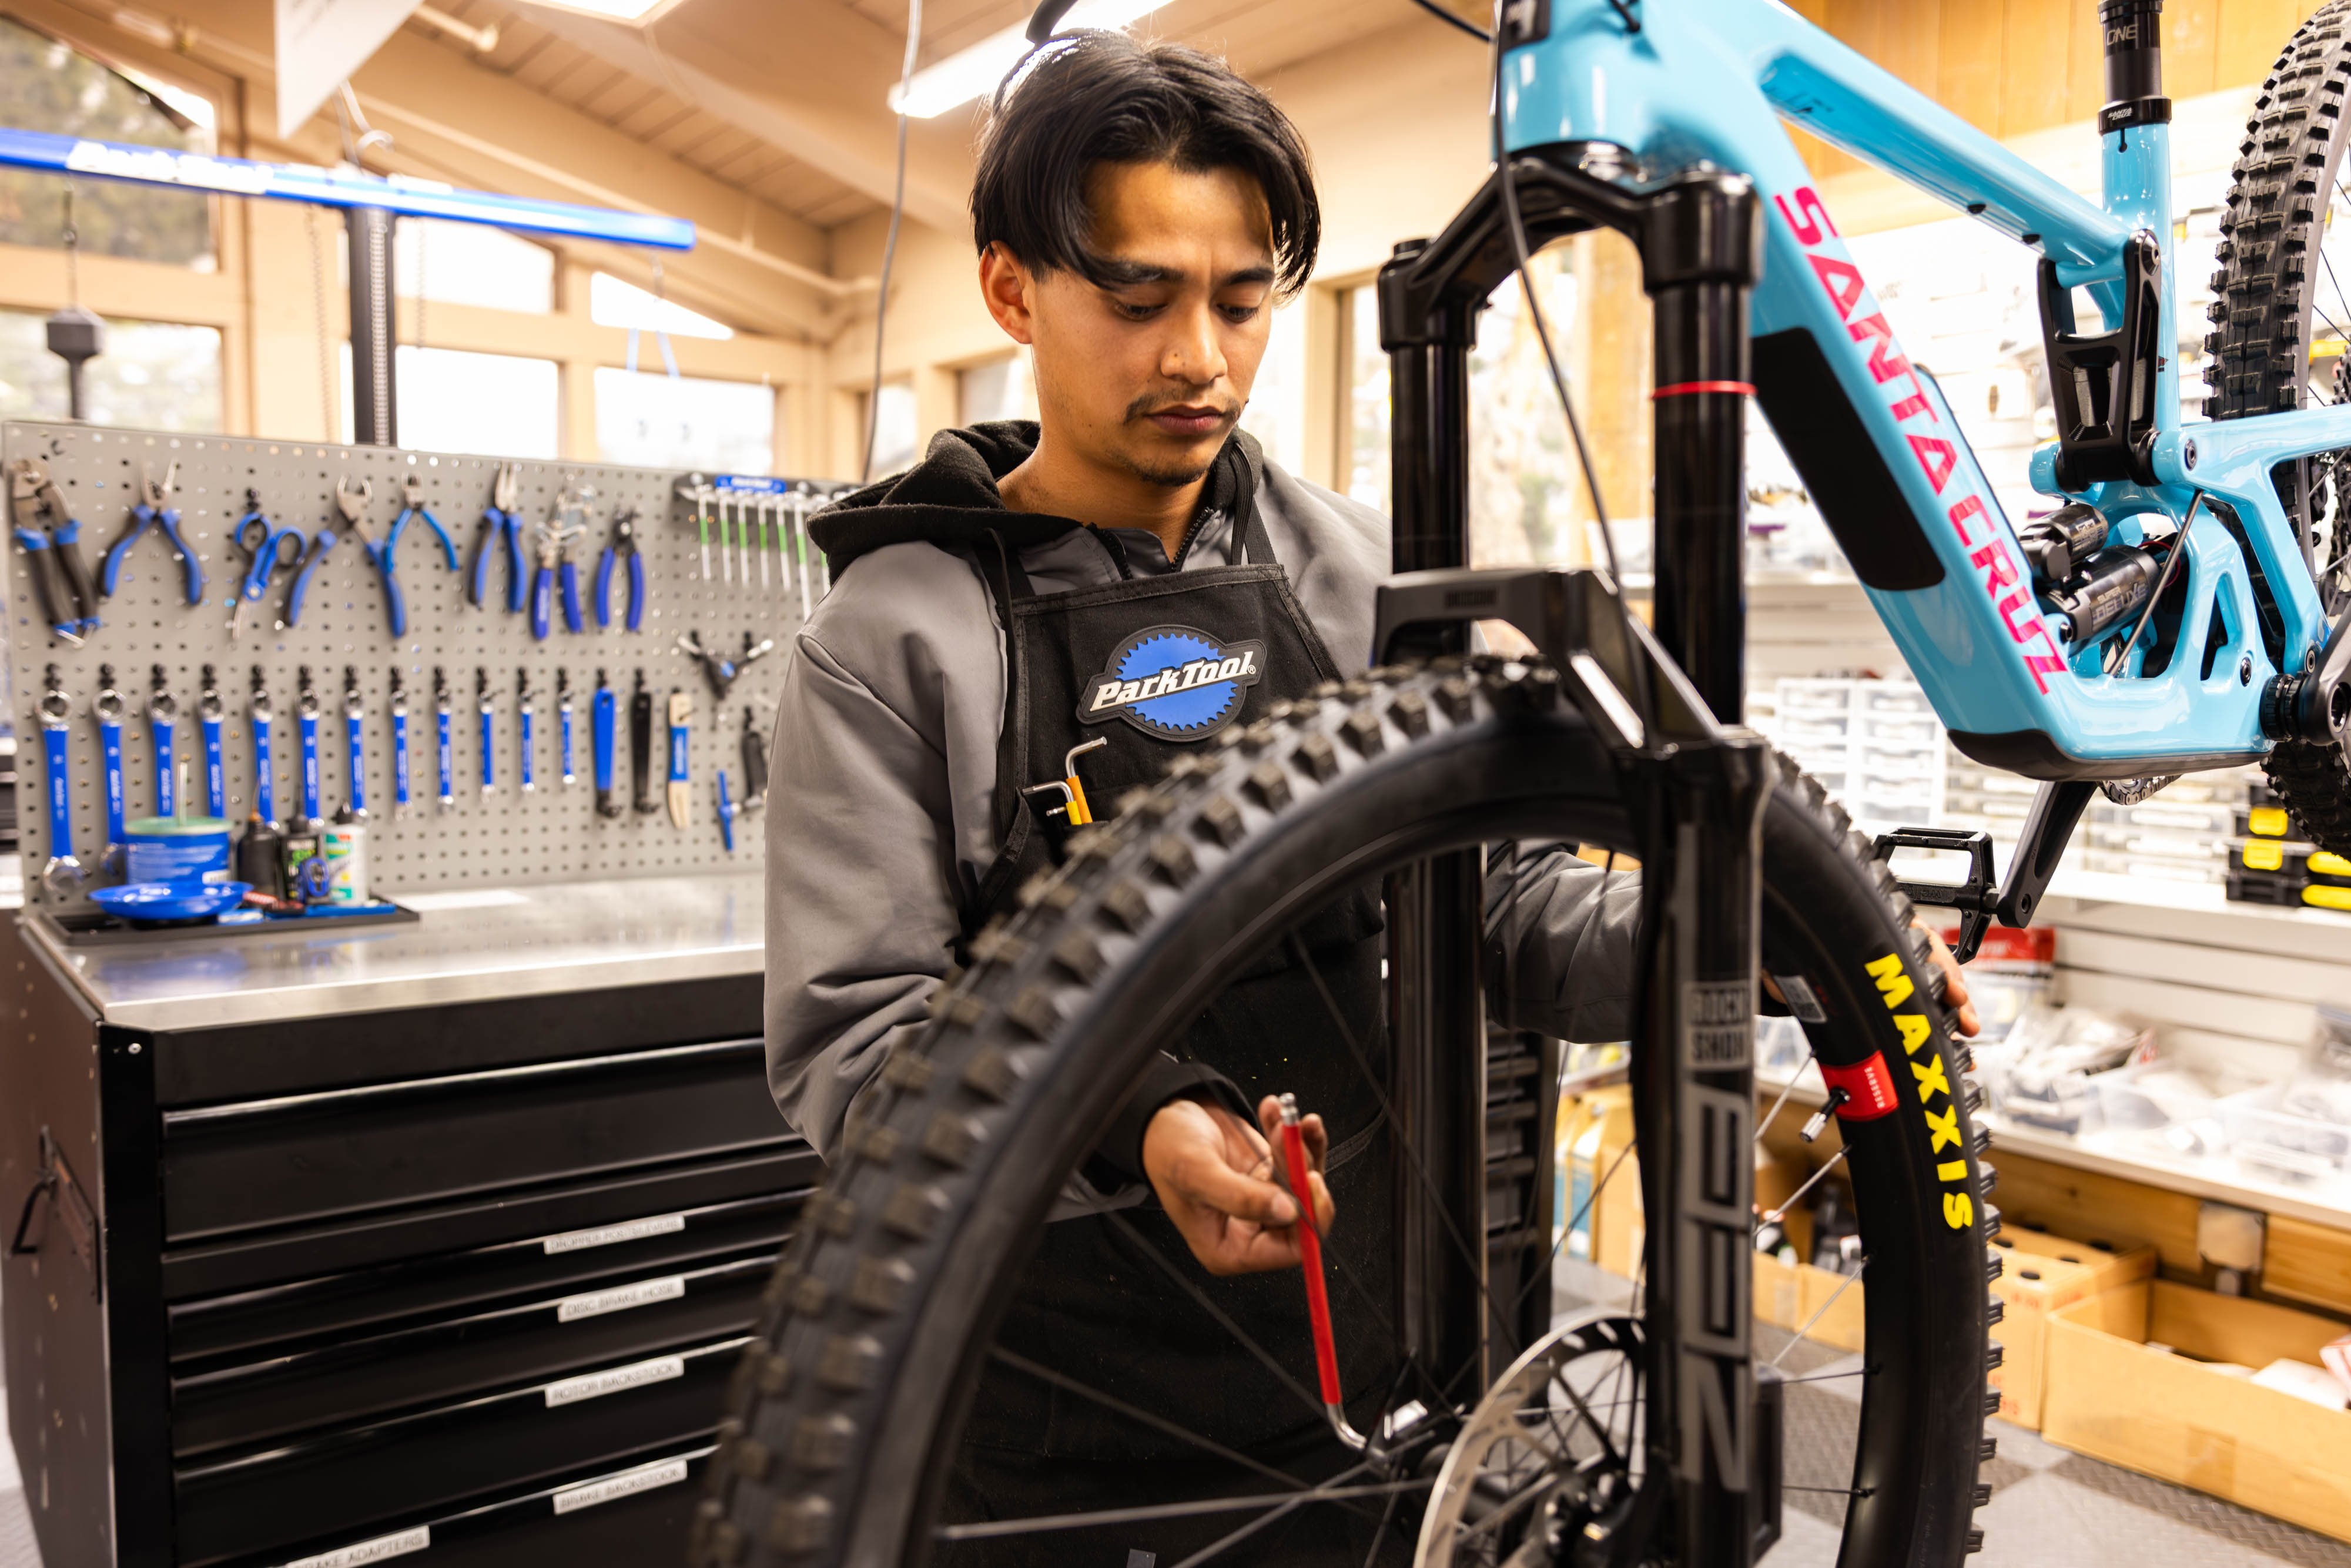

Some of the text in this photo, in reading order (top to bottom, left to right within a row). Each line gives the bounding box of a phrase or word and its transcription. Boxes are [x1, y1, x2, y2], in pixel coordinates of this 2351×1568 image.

[1773, 186, 2068, 695] SANTA CRUZ
[2095, 582, 2146, 619] DELUXE
[2097, 587, 2121, 604] SUPER
[1864, 1067, 1886, 1110] RESERVE
[1864, 953, 1973, 1229] MAXXIS
[348, 1532, 424, 1563] ADAPTERS
